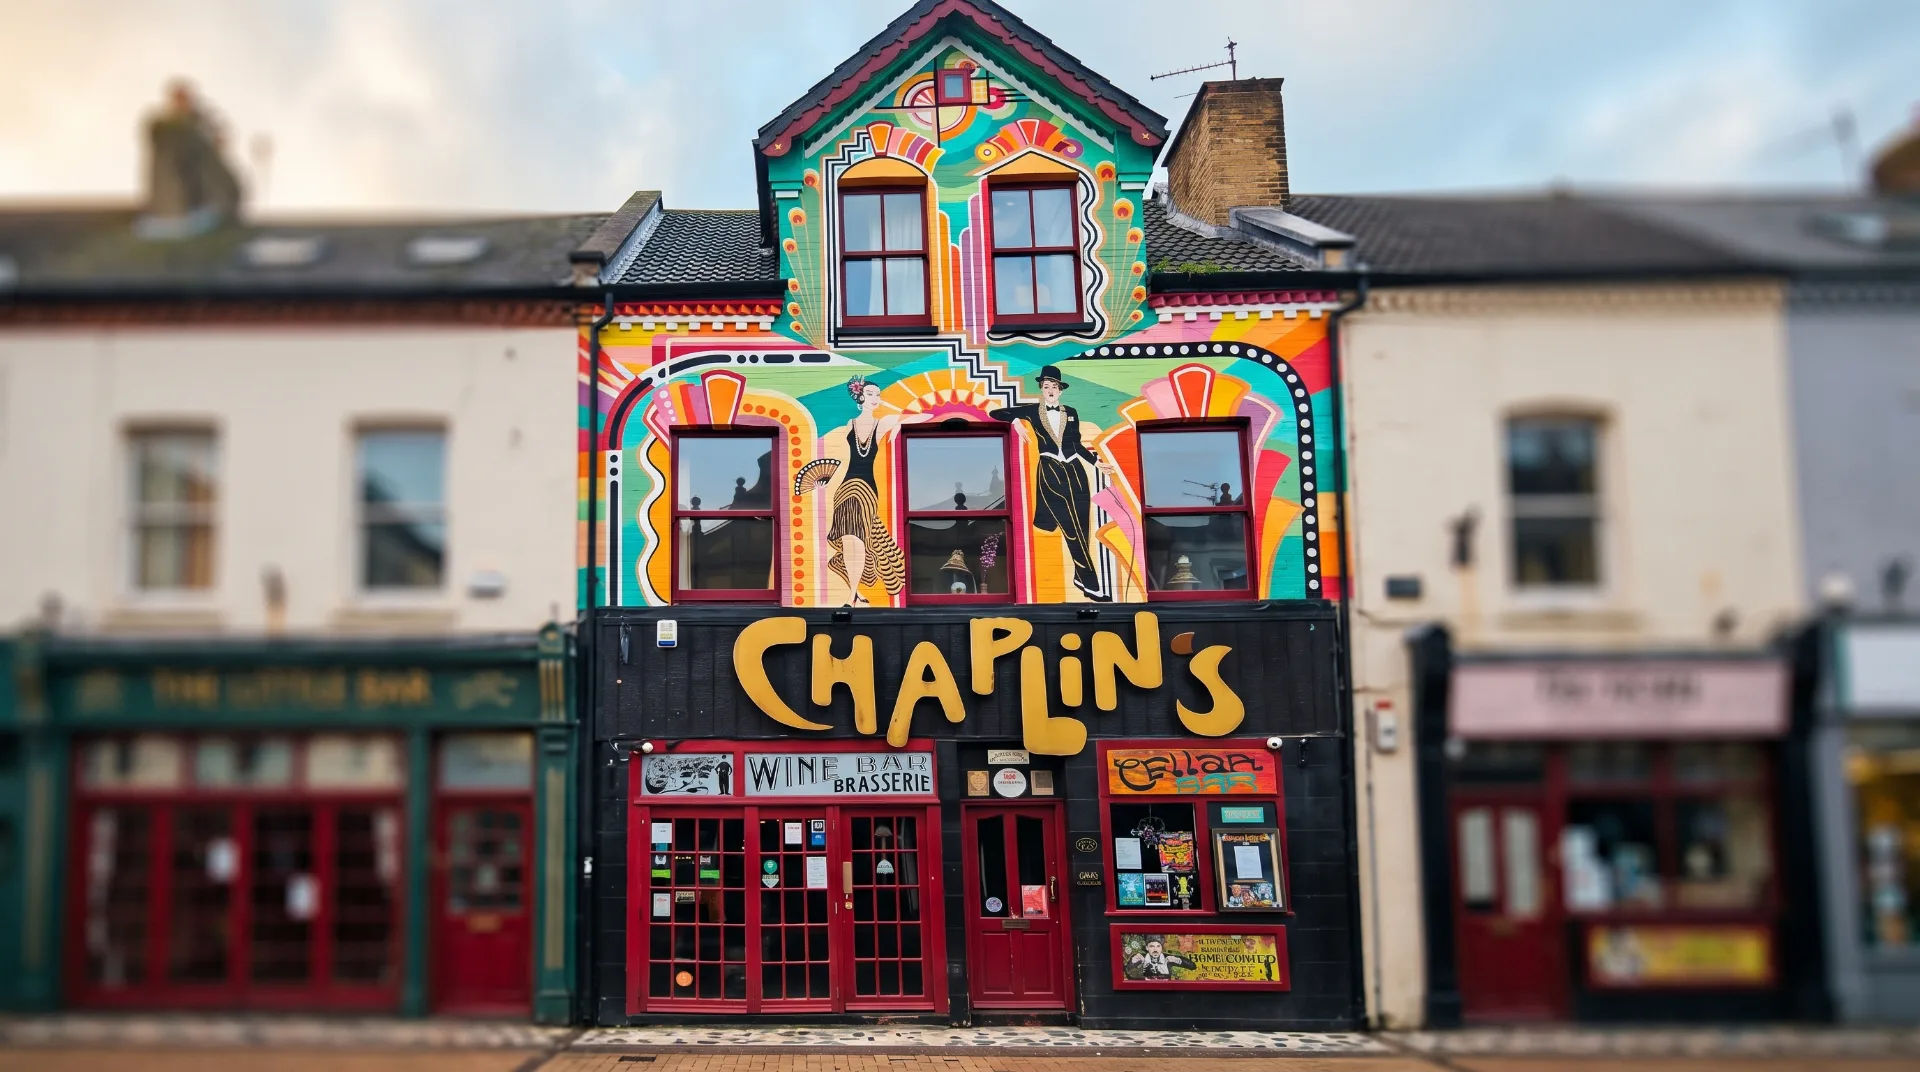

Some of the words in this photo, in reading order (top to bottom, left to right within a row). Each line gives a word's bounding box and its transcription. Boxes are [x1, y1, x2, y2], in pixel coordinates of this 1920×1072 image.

[748, 756, 840, 792] WINE
[856, 754, 927, 774] BAR
[834, 772, 930, 793] BRASSERIE
[1176, 771, 1258, 793] BAR
